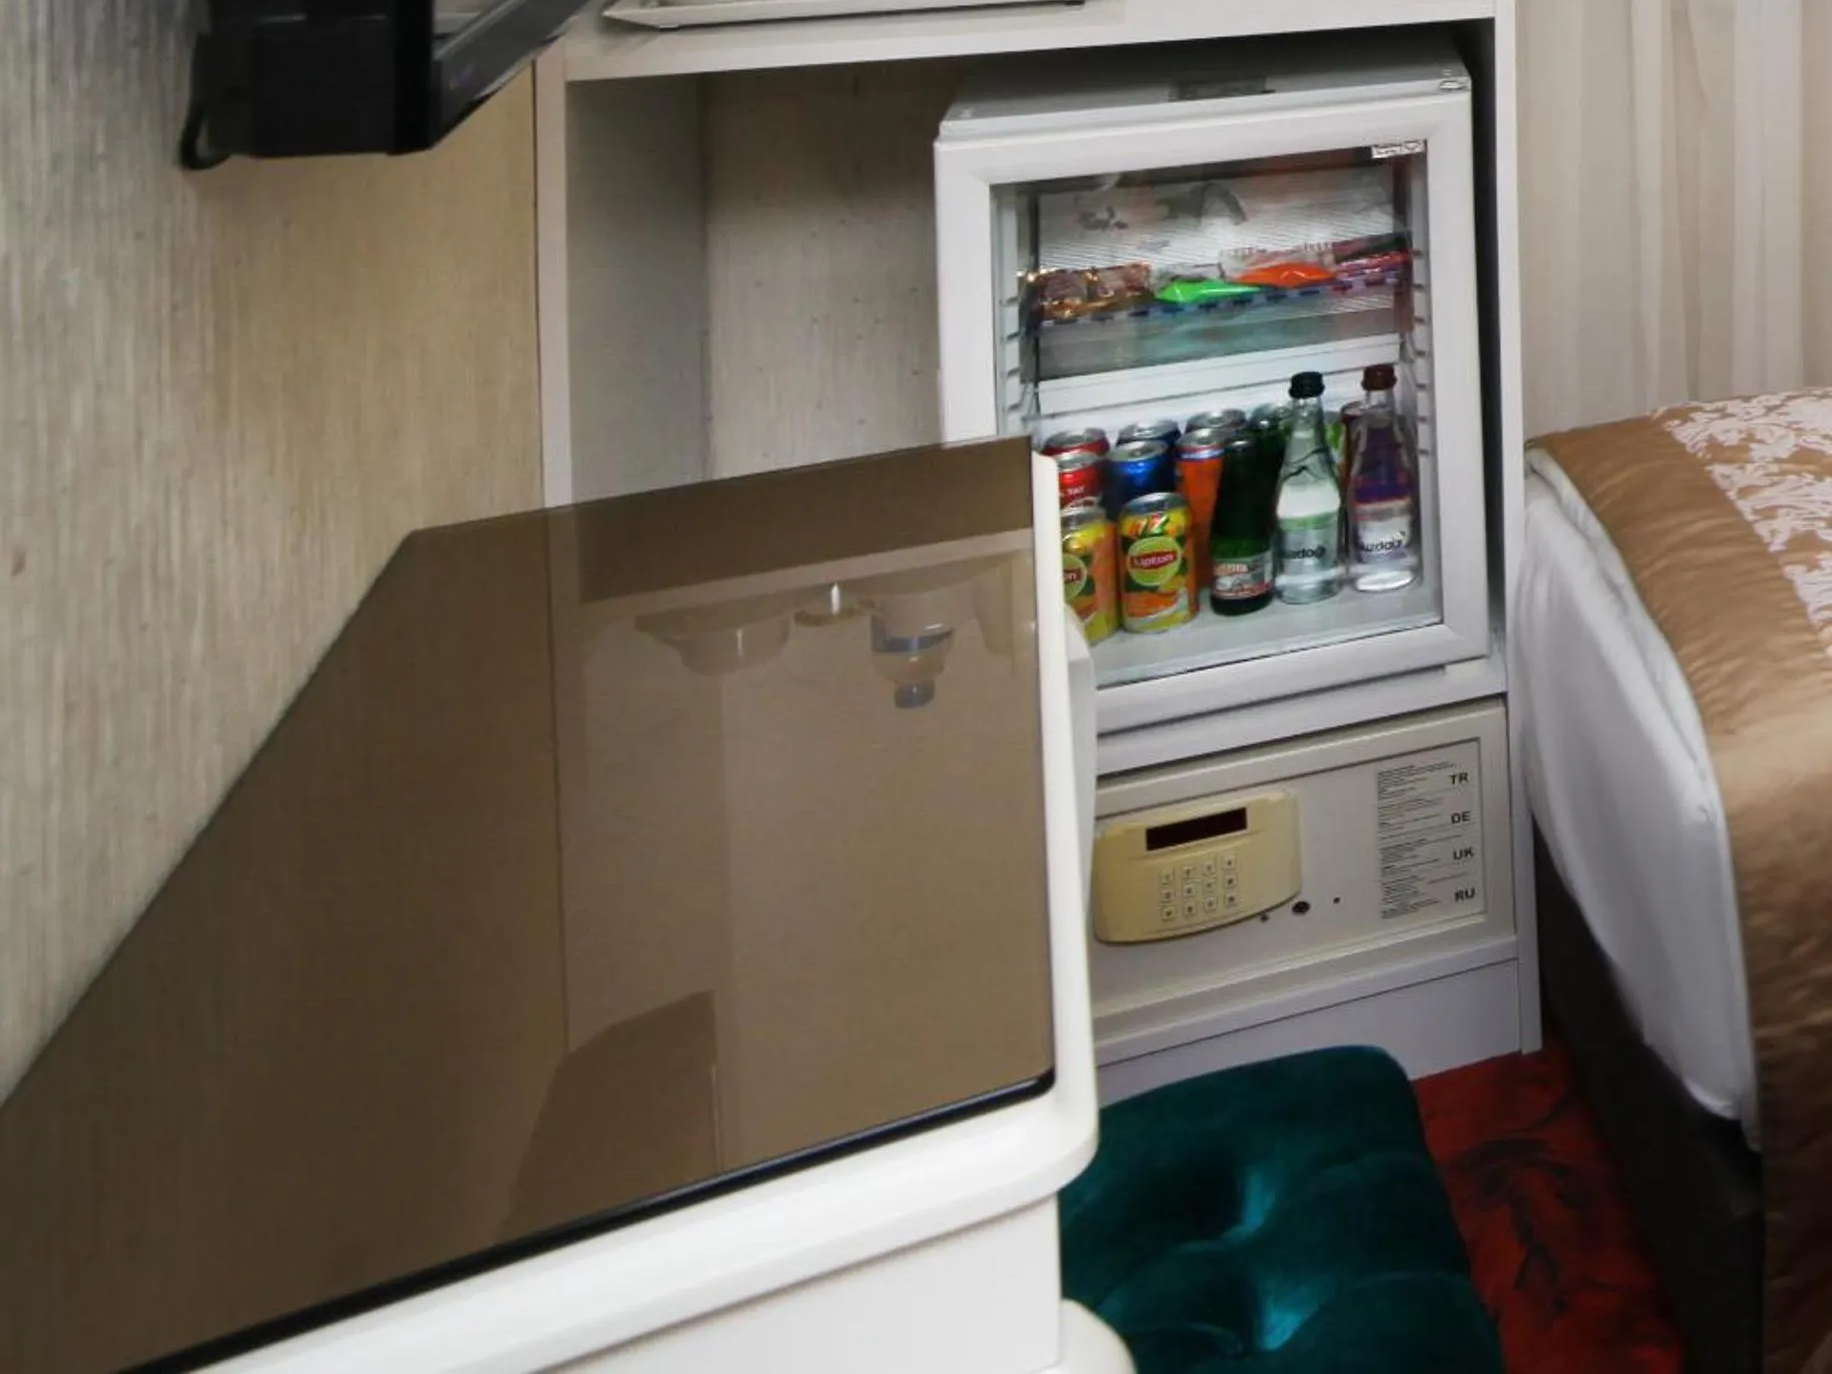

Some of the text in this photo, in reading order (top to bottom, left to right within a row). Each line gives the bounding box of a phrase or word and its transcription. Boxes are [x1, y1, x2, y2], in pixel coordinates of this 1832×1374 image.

[1450, 772, 1469, 785] TR
[1451, 810, 1472, 824] DE
[1453, 847, 1475, 861] UK
